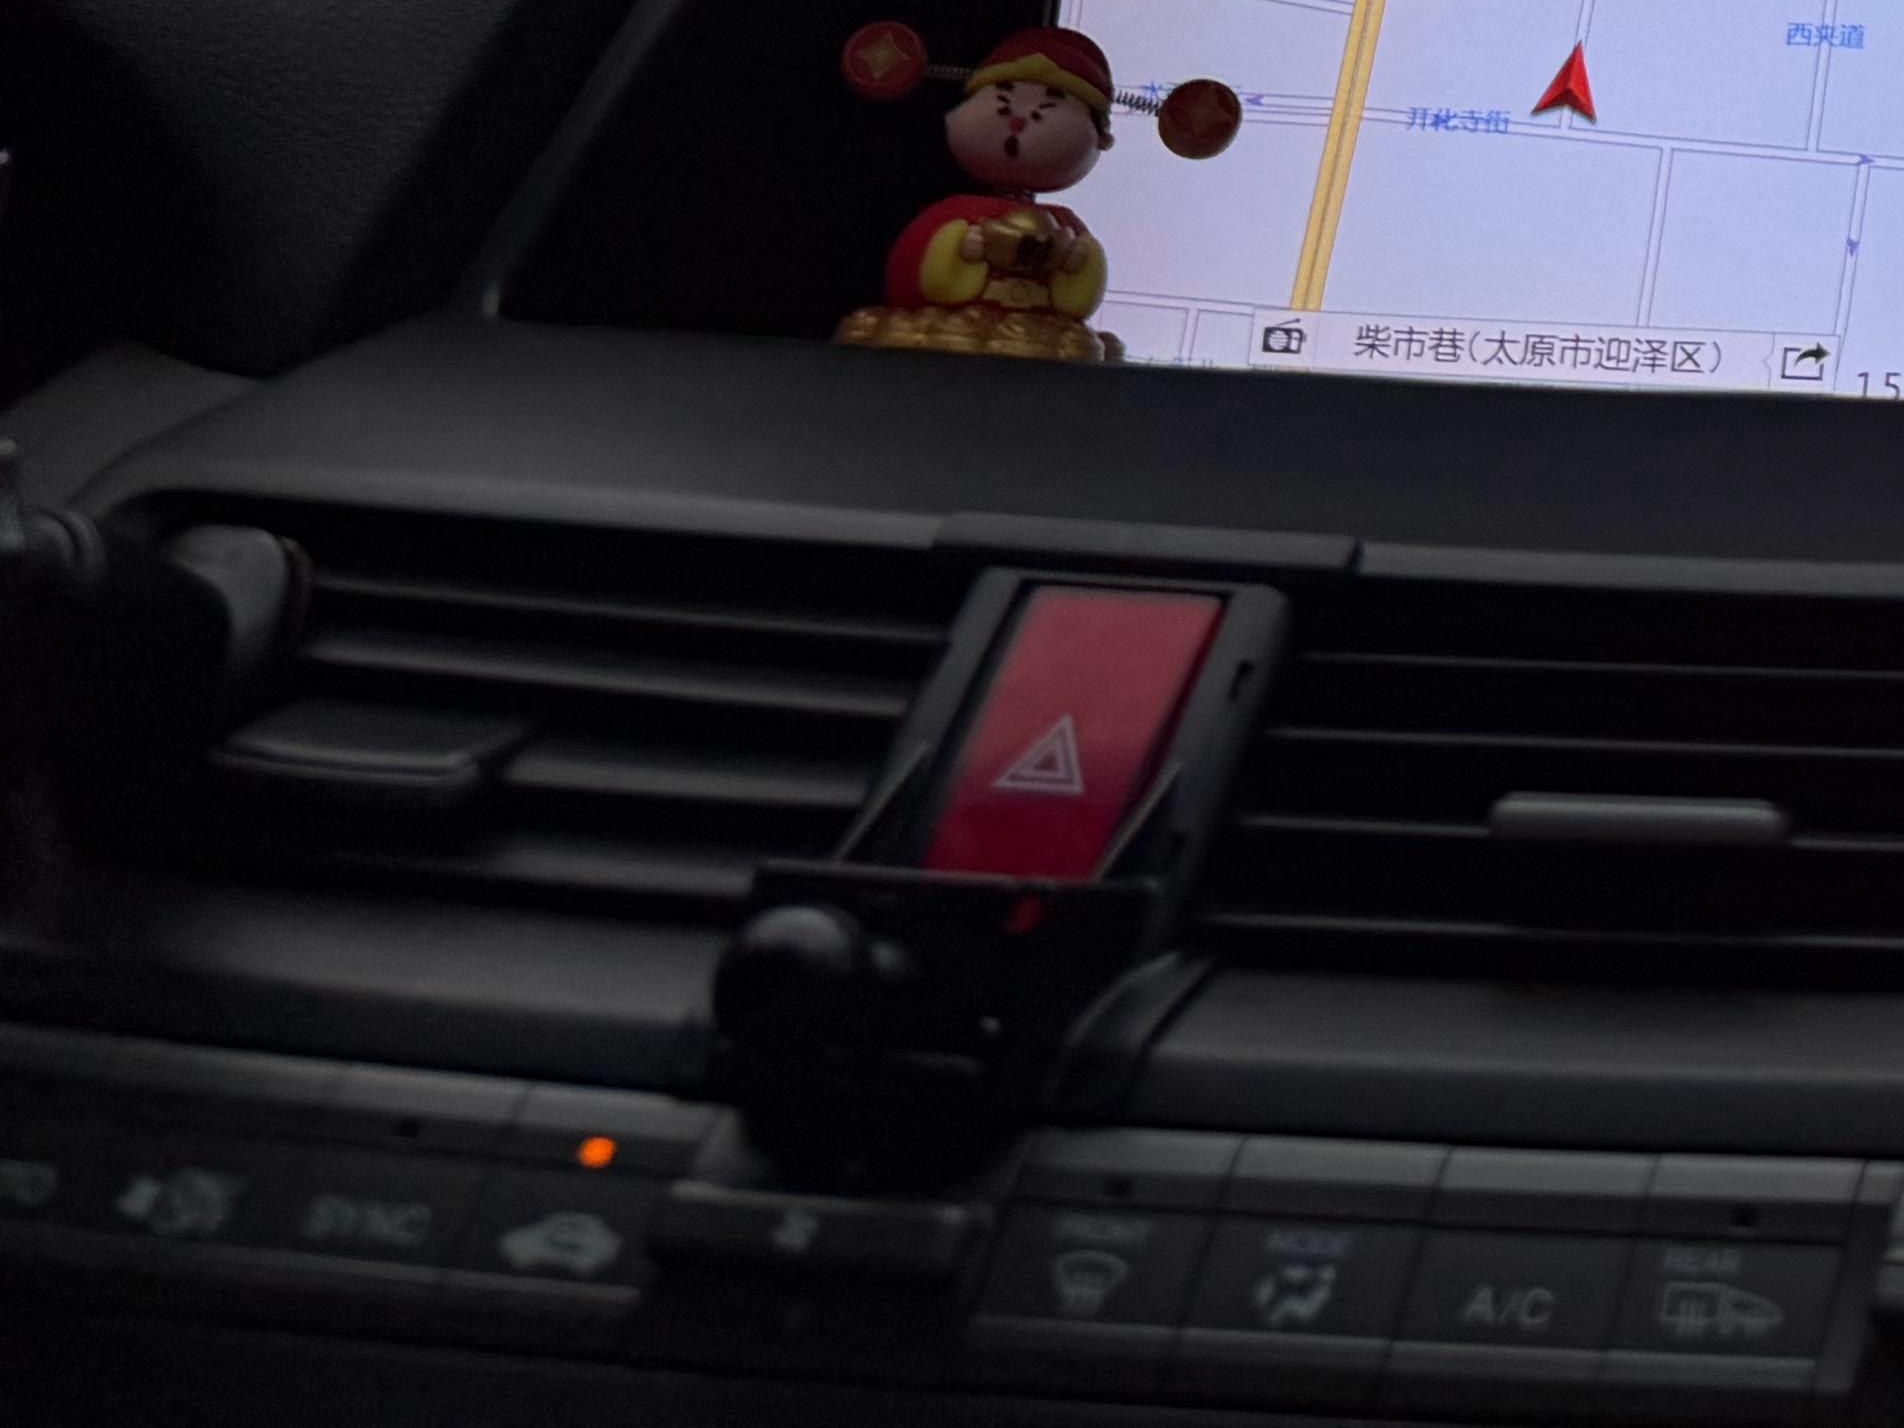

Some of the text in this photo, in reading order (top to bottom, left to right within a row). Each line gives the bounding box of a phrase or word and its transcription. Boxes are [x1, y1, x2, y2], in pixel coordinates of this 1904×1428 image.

[1785, 21, 1866, 50] 西夹道
[1462, 1284, 1555, 1327] A/C
